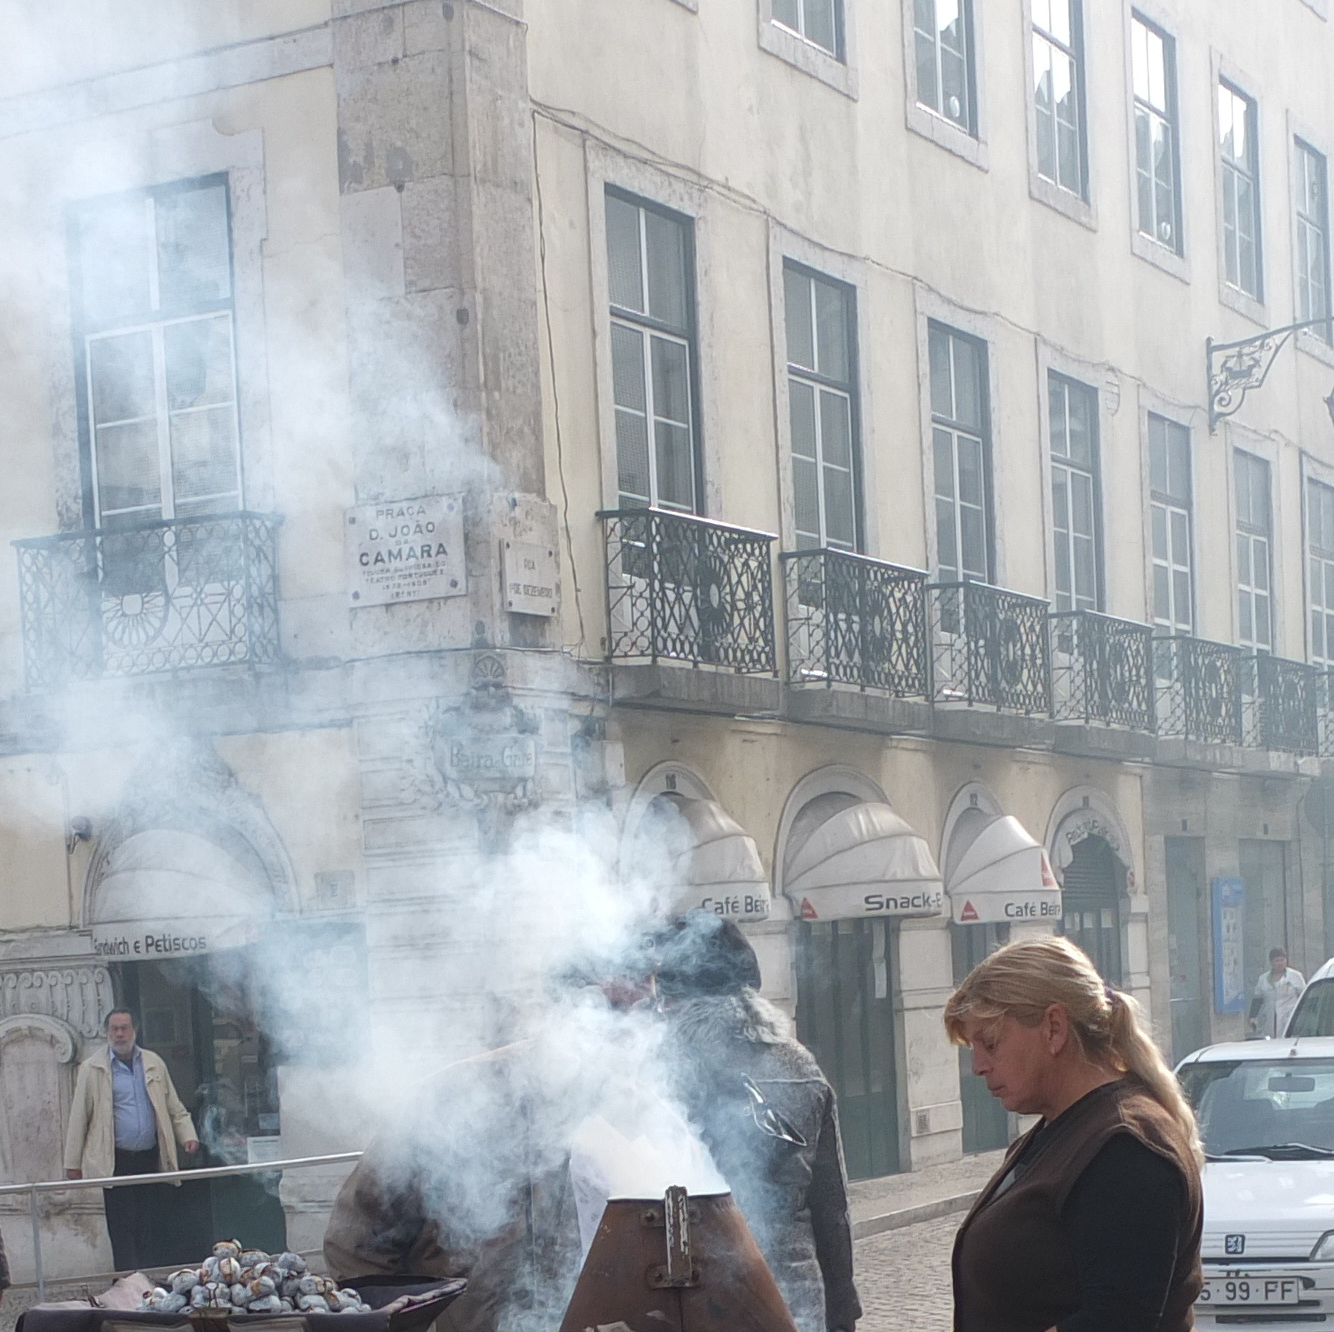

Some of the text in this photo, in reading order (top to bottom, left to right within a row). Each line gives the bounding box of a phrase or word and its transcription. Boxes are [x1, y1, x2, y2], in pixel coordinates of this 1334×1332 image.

[376, 505, 427, 520] PRAÇA
[369, 520, 436, 541] D. JOÃO
[359, 542, 449, 567] CAMARA
[701, 895, 740, 914] Café
[1004, 900, 1037, 918] Café
[133, 941, 141, 954] e
[145, 934, 207, 954] Petiscos
